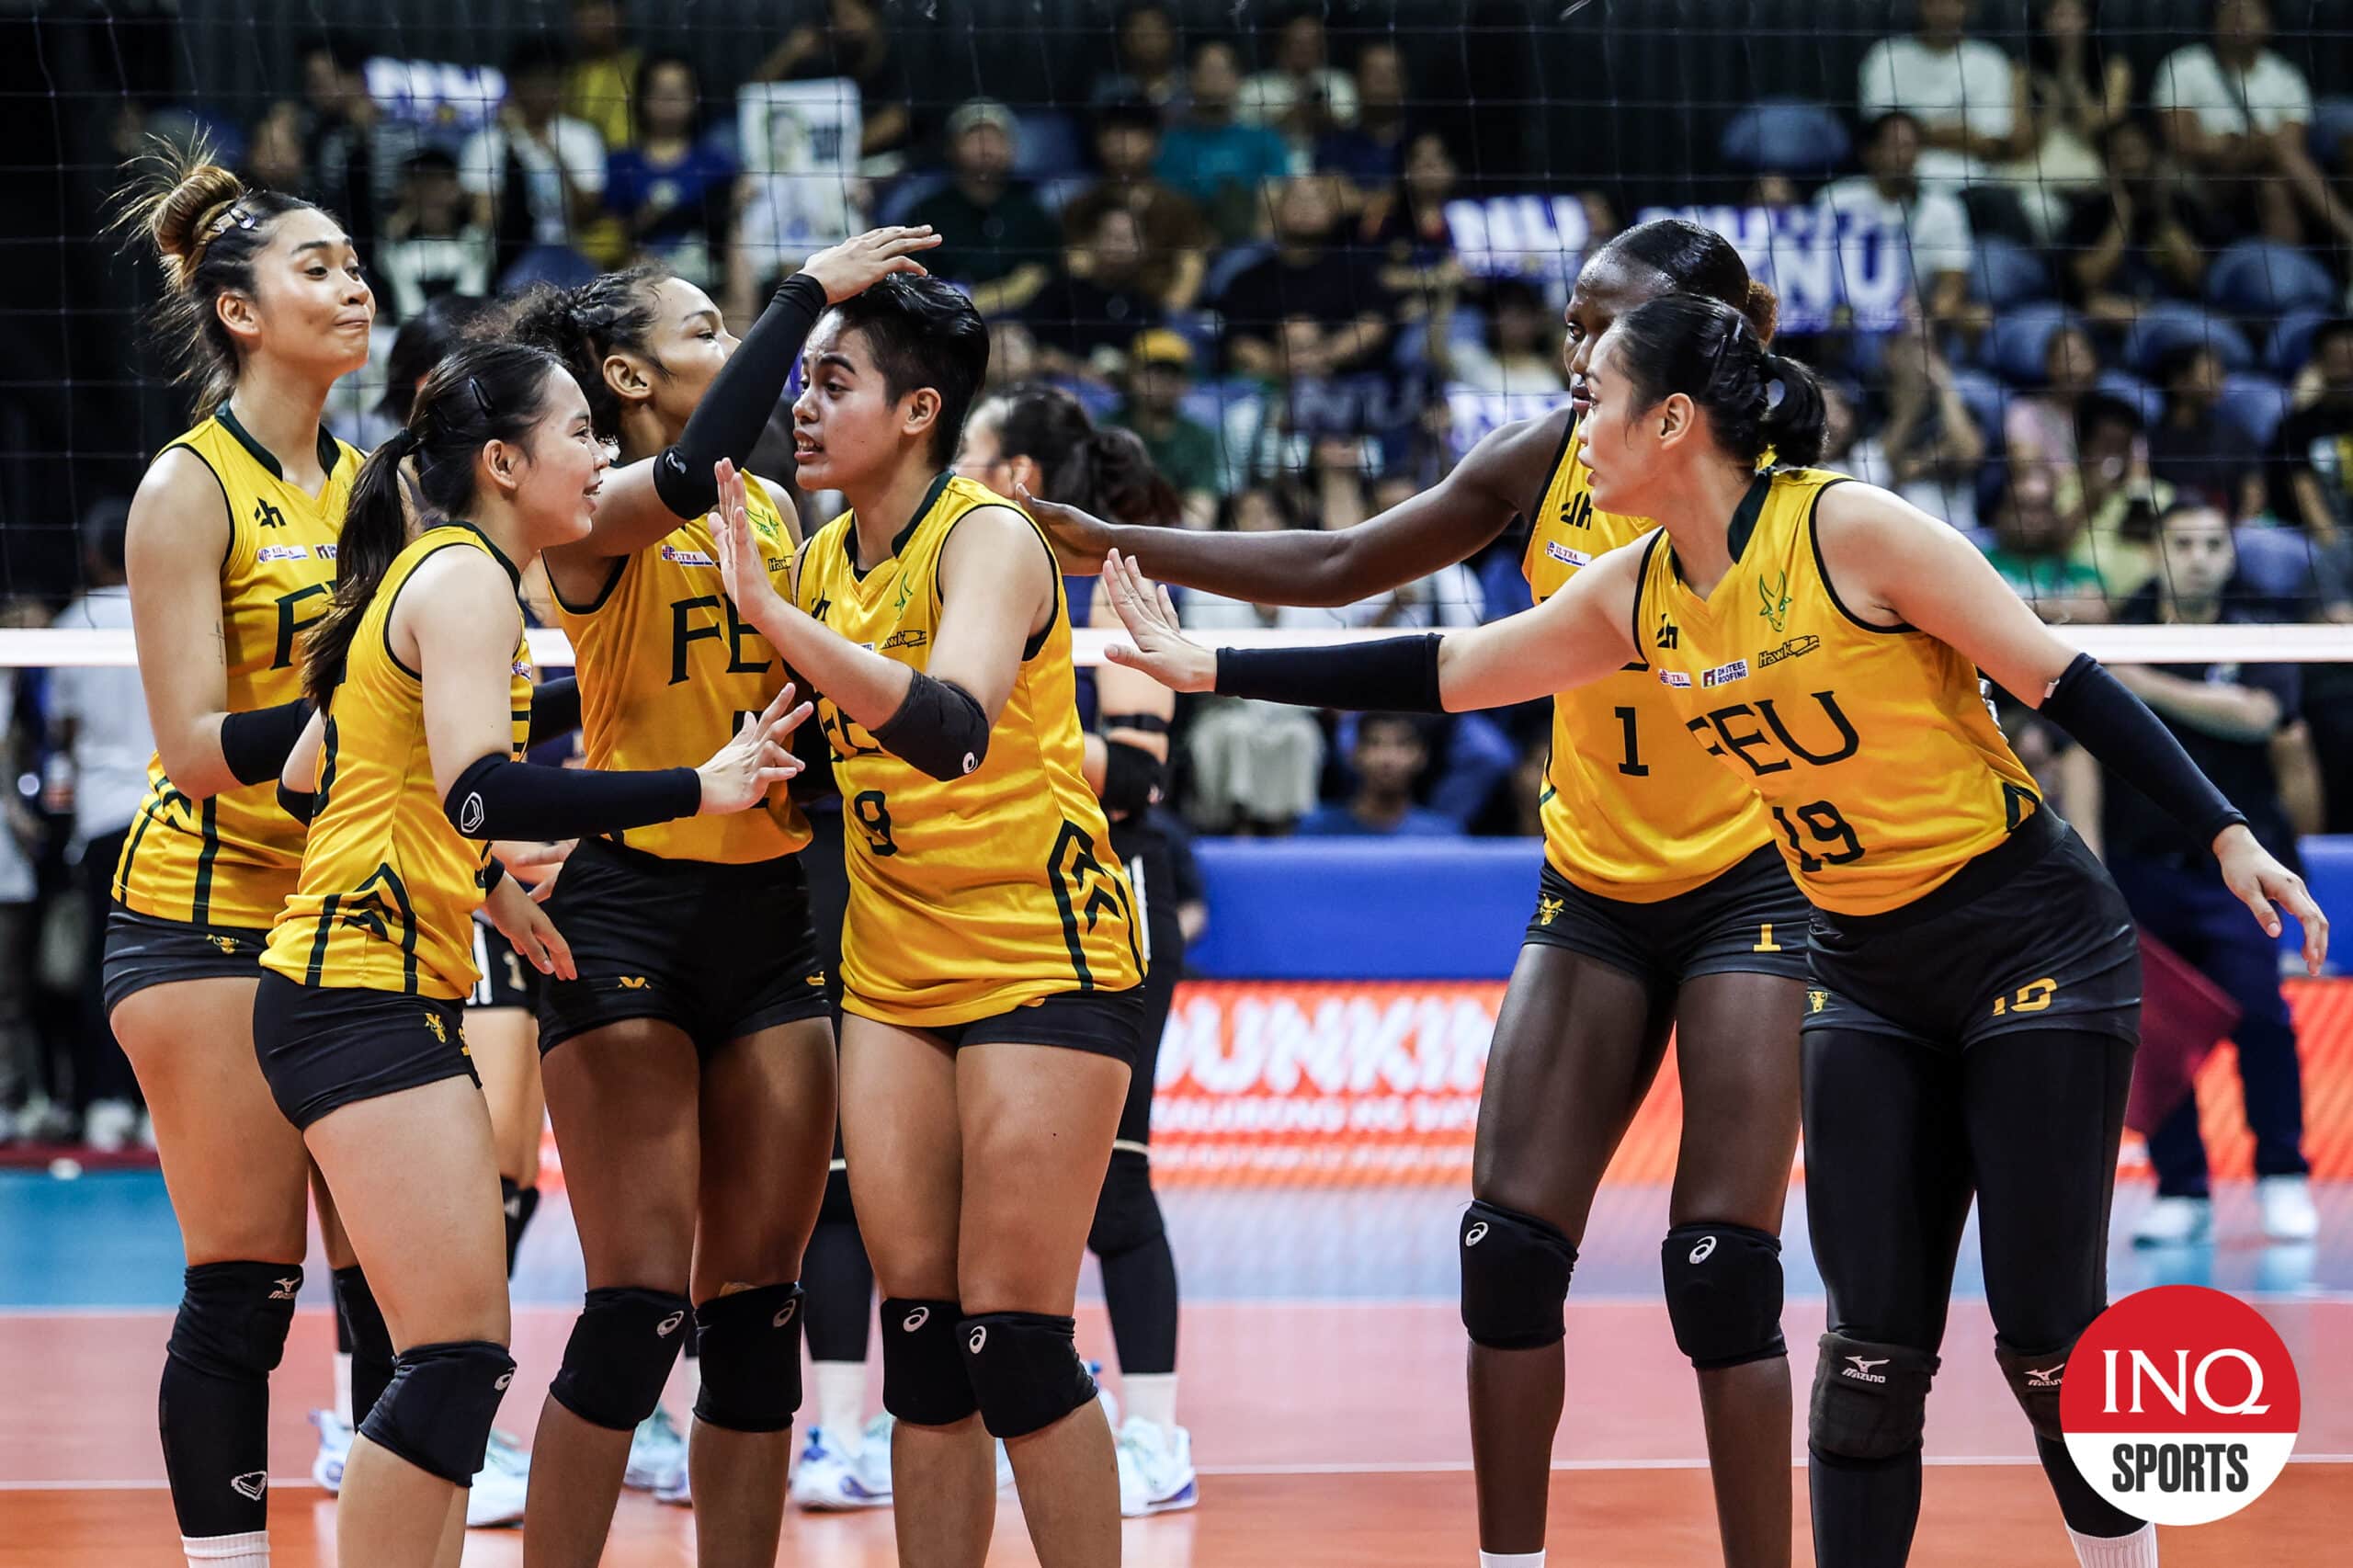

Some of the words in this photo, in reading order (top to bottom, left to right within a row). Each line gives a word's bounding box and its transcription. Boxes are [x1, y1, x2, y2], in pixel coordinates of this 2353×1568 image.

[1615, 706, 1650, 777] 1
[853, 790, 898, 857] 9
[1772, 800, 1866, 873] 19
